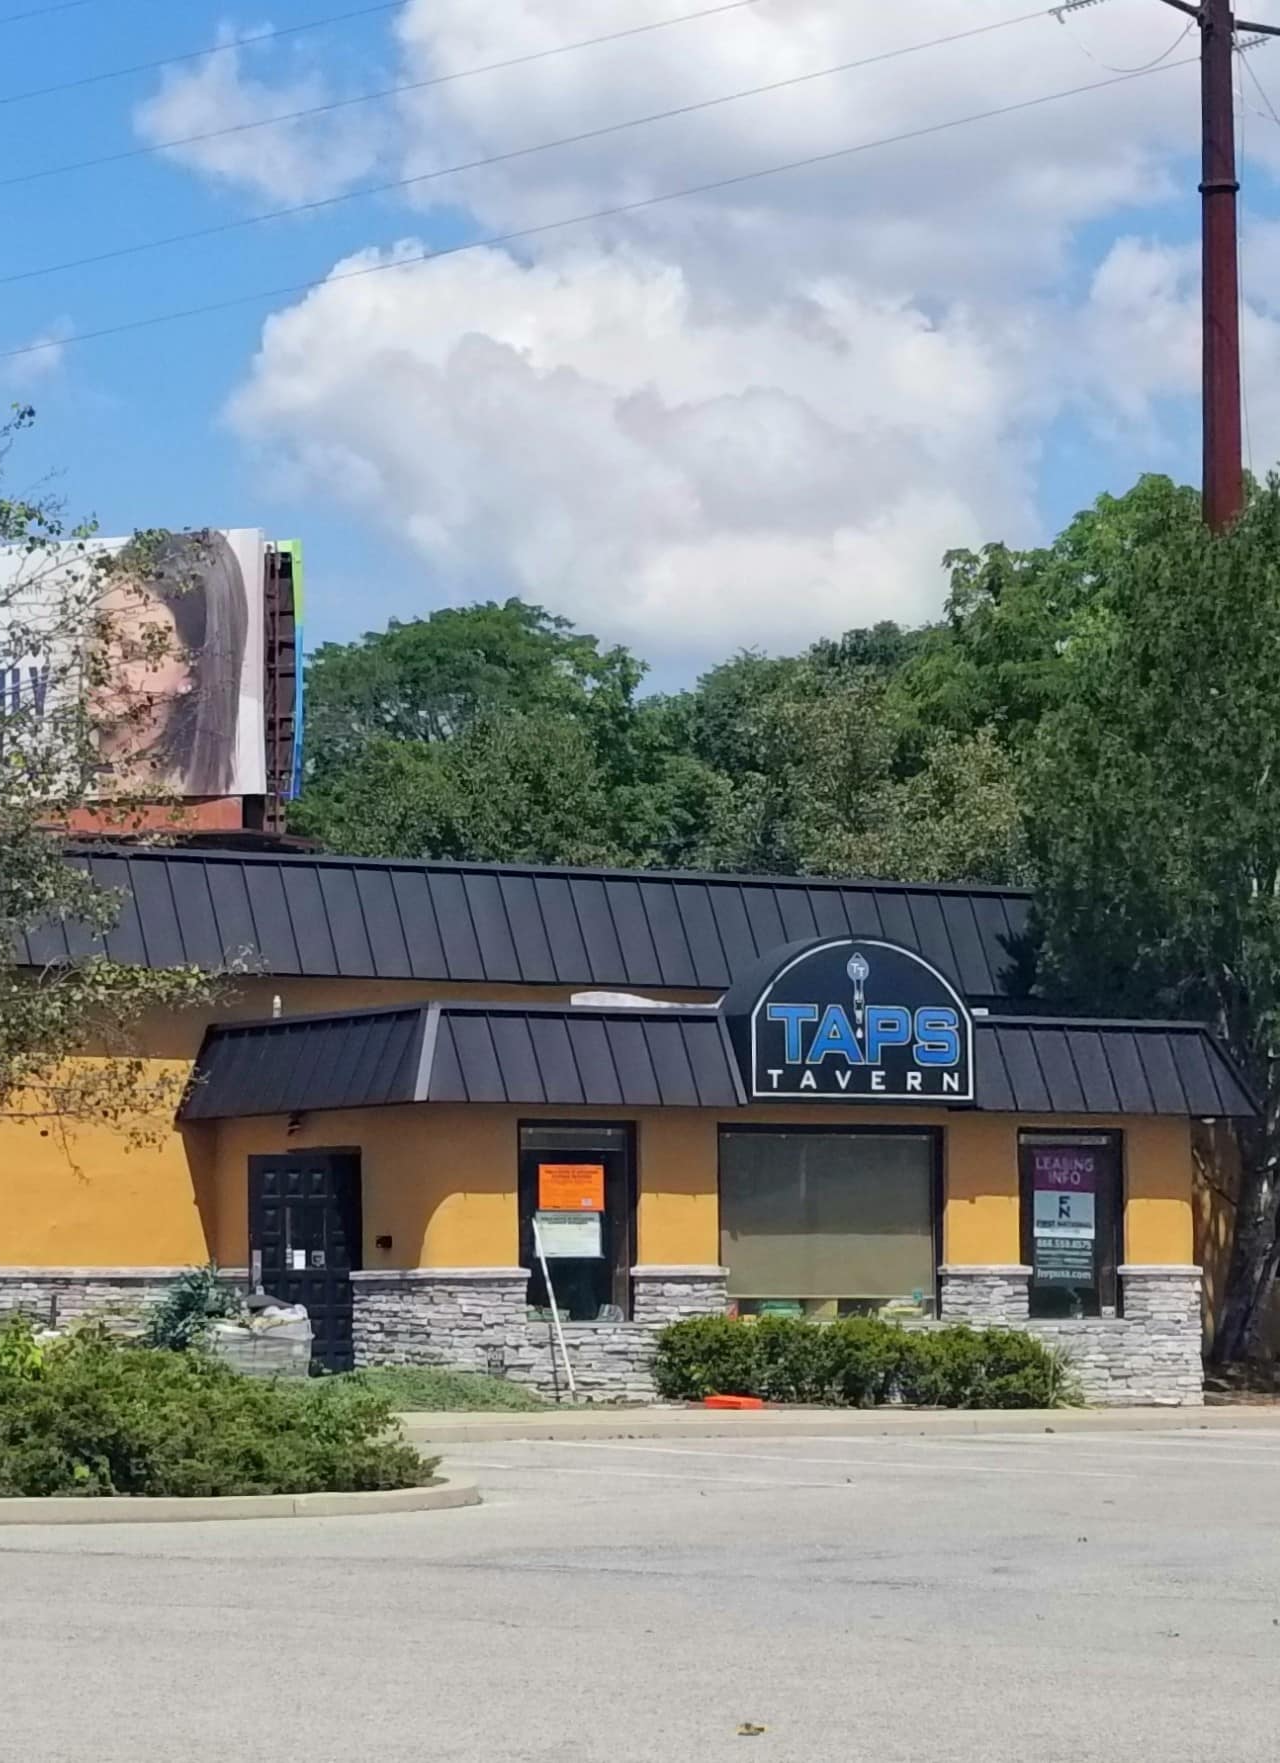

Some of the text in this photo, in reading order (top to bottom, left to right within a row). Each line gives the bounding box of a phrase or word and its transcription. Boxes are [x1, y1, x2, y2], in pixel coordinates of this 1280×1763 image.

[766, 1003, 961, 1067] TAPS
[767, 1069, 959, 1091] TAVERN
[1035, 1157, 1094, 1172] LEASING
[1048, 1170, 1081, 1185] INFO
